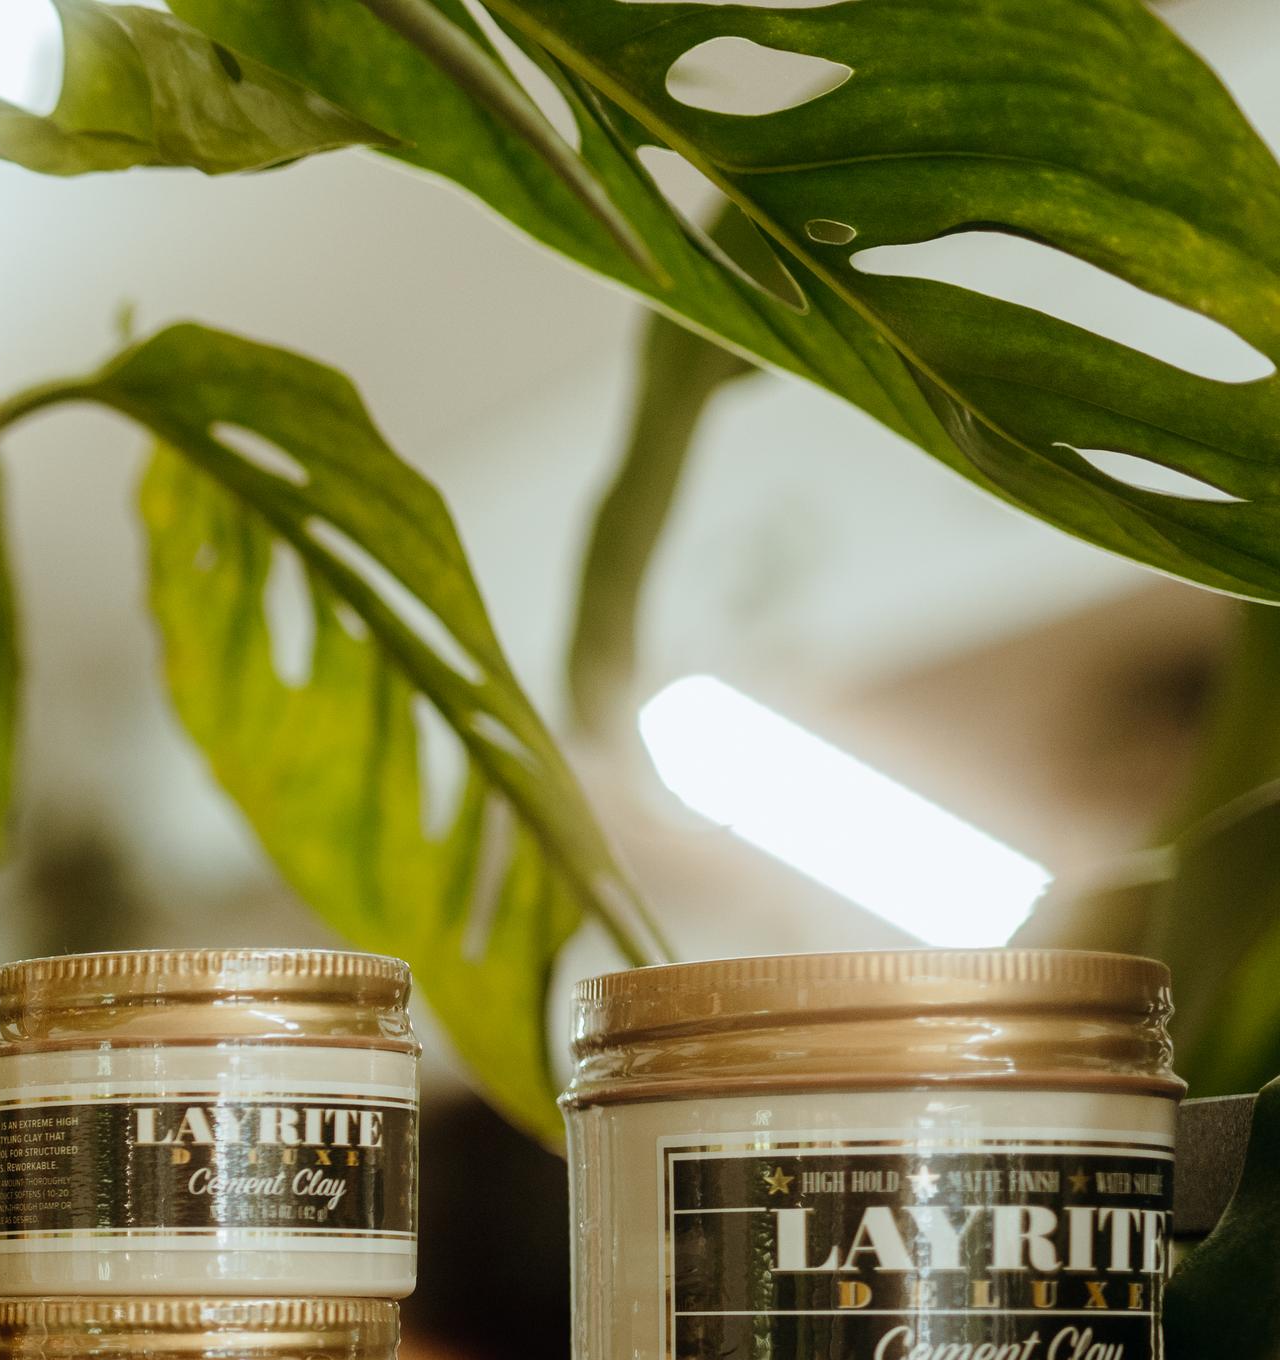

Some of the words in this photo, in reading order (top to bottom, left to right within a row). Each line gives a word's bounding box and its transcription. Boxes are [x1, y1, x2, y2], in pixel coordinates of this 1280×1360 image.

[19, 1118, 54, 1129] EXTREME
[55, 1117, 79, 1126] HIGH
[135, 1106, 384, 1149] LAYRITE
[23, 1132, 42, 1143] CLAY
[44, 1131, 66, 1141] THAT
[9, 1148, 23, 1158] FOR
[24, 1146, 79, 1157] STRUCTURED
[170, 1147, 362, 1167] DLUXE
[187, 1167, 286, 1197] Cement
[291, 1167, 347, 1211] Clay
[801, 1171, 845, 1194] HIGH
[851, 1170, 900, 1193] HOLD
[1007, 1170, 1060, 1194] FINISH
[770, 1205, 1166, 1274] LAYRITE
[837, 1279, 1145, 1310] DELUXE
